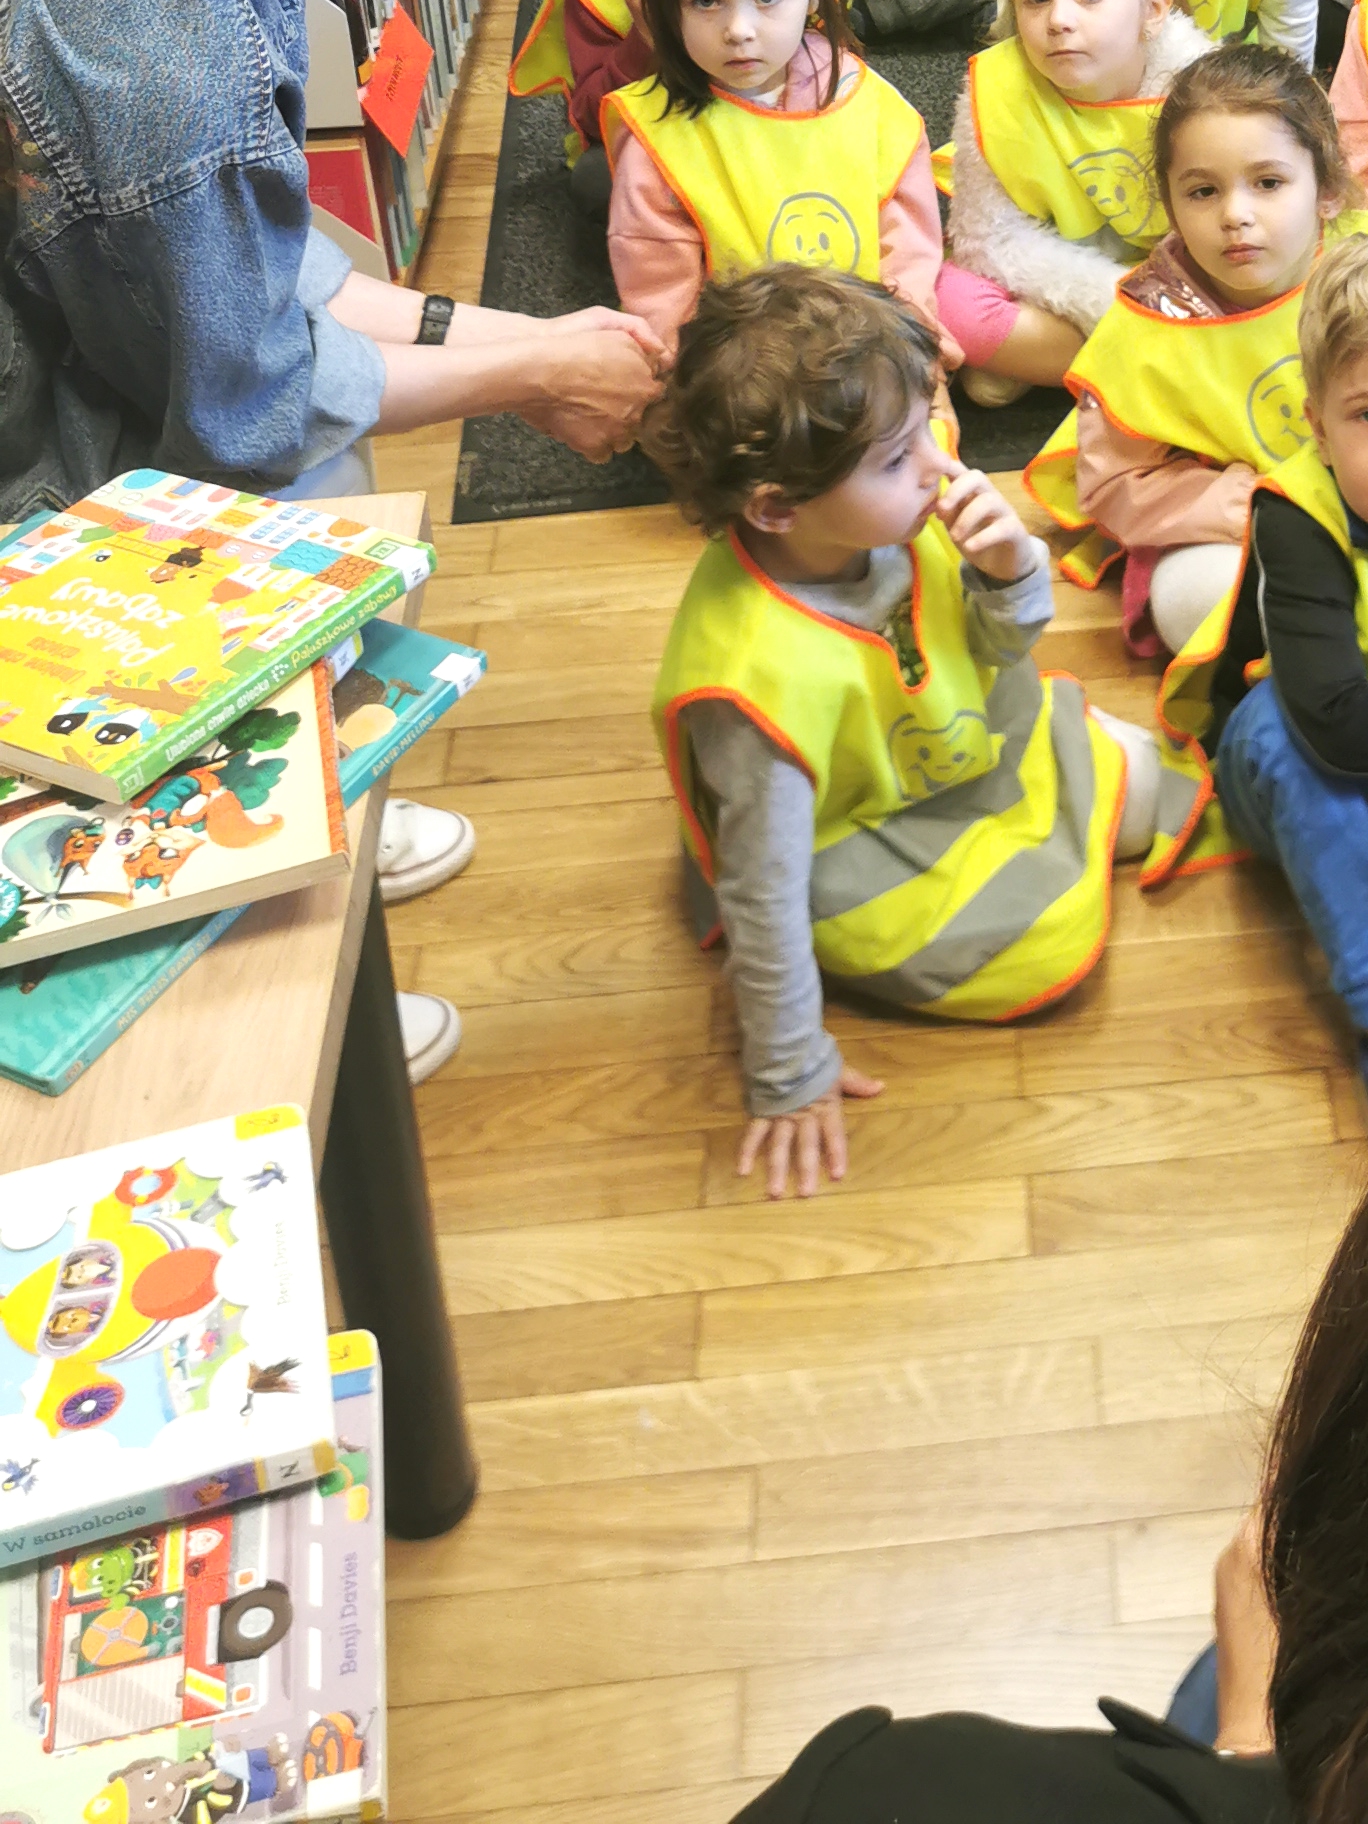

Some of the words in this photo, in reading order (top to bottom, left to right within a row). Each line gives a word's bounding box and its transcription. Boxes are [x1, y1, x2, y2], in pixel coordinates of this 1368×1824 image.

[50, 577, 185, 628] zabawy
[290, 616, 356, 668] Paluszkowe
[357, 585, 397, 619] zabawy
[4, 1536, 27, 1554] W
[32, 1503, 147, 1544] samolocie
[340, 1552, 358, 1619] Davies
[339, 1623, 362, 1676] Benji
